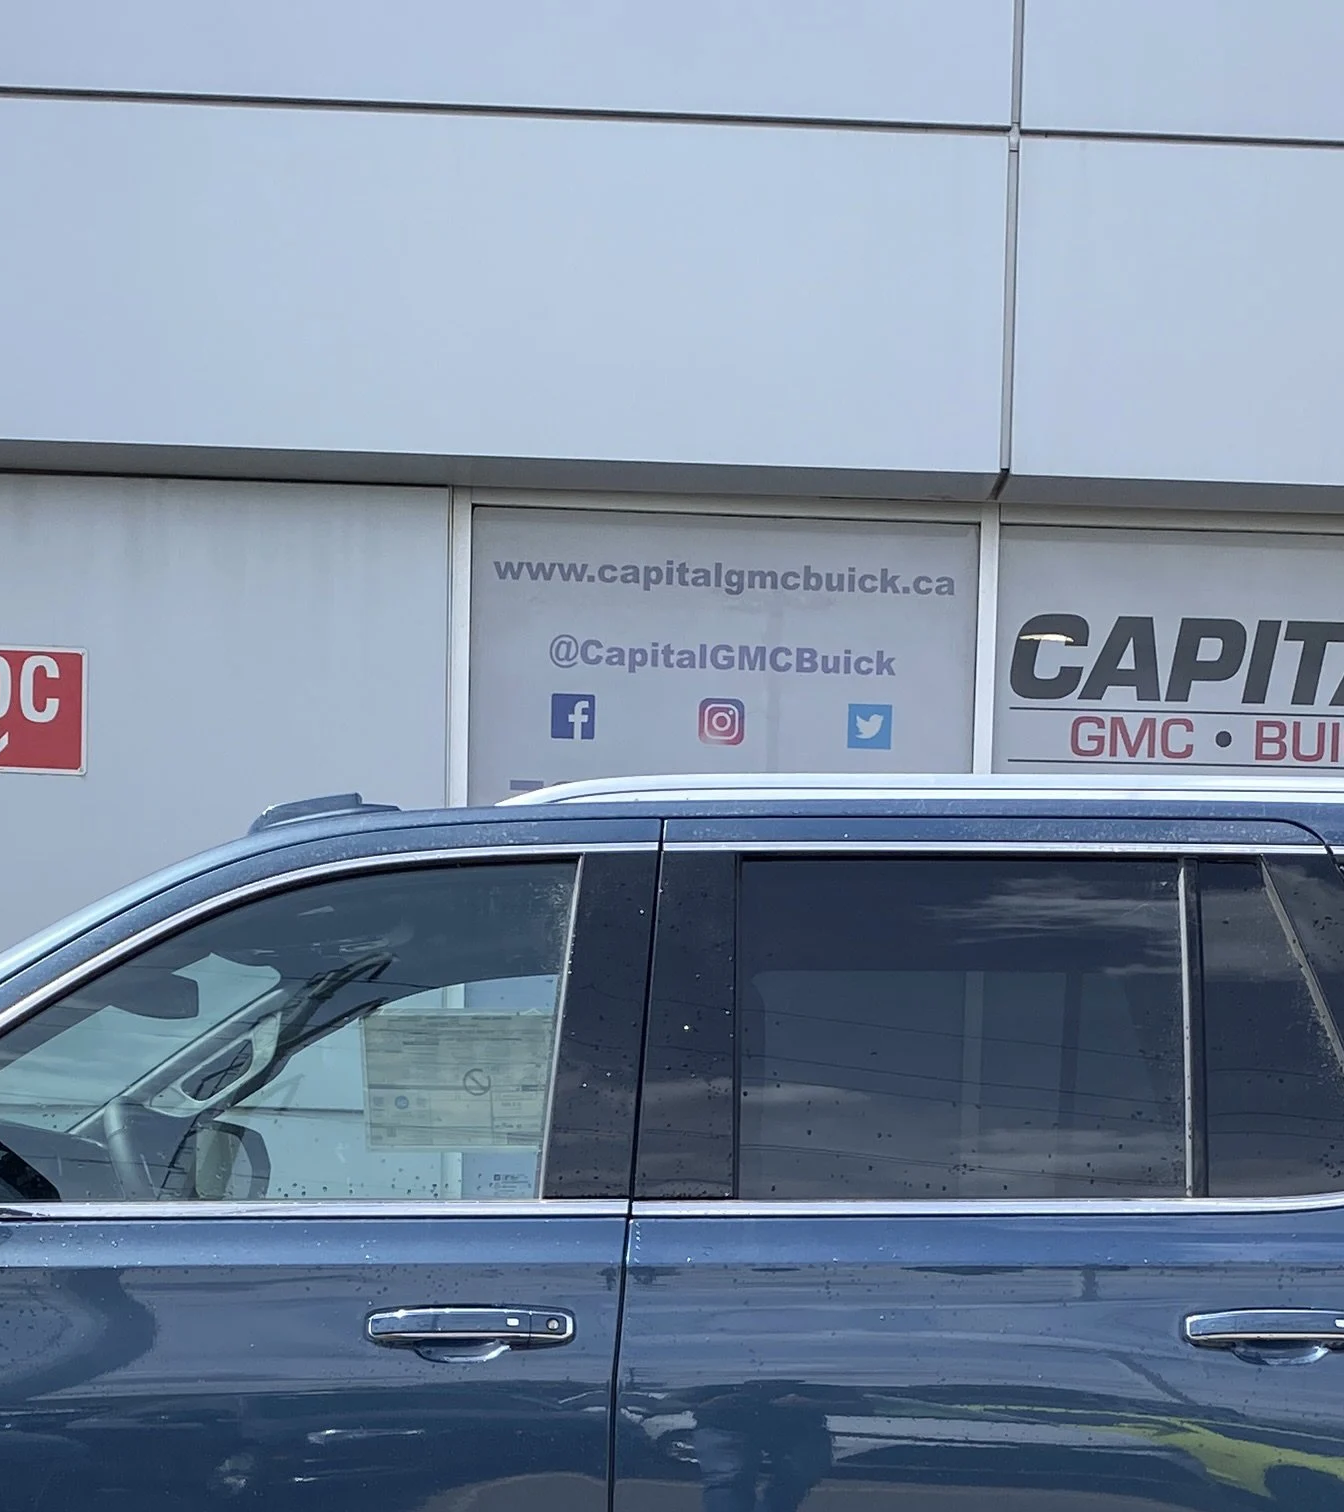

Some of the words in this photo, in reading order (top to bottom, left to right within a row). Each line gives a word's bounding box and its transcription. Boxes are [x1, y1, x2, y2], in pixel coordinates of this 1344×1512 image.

[493, 559, 955, 596] www.capitalgmcbuick.ca
[549, 634, 896, 676] @CapitalGMCBuick
[1070, 715, 1194, 758] GMC
